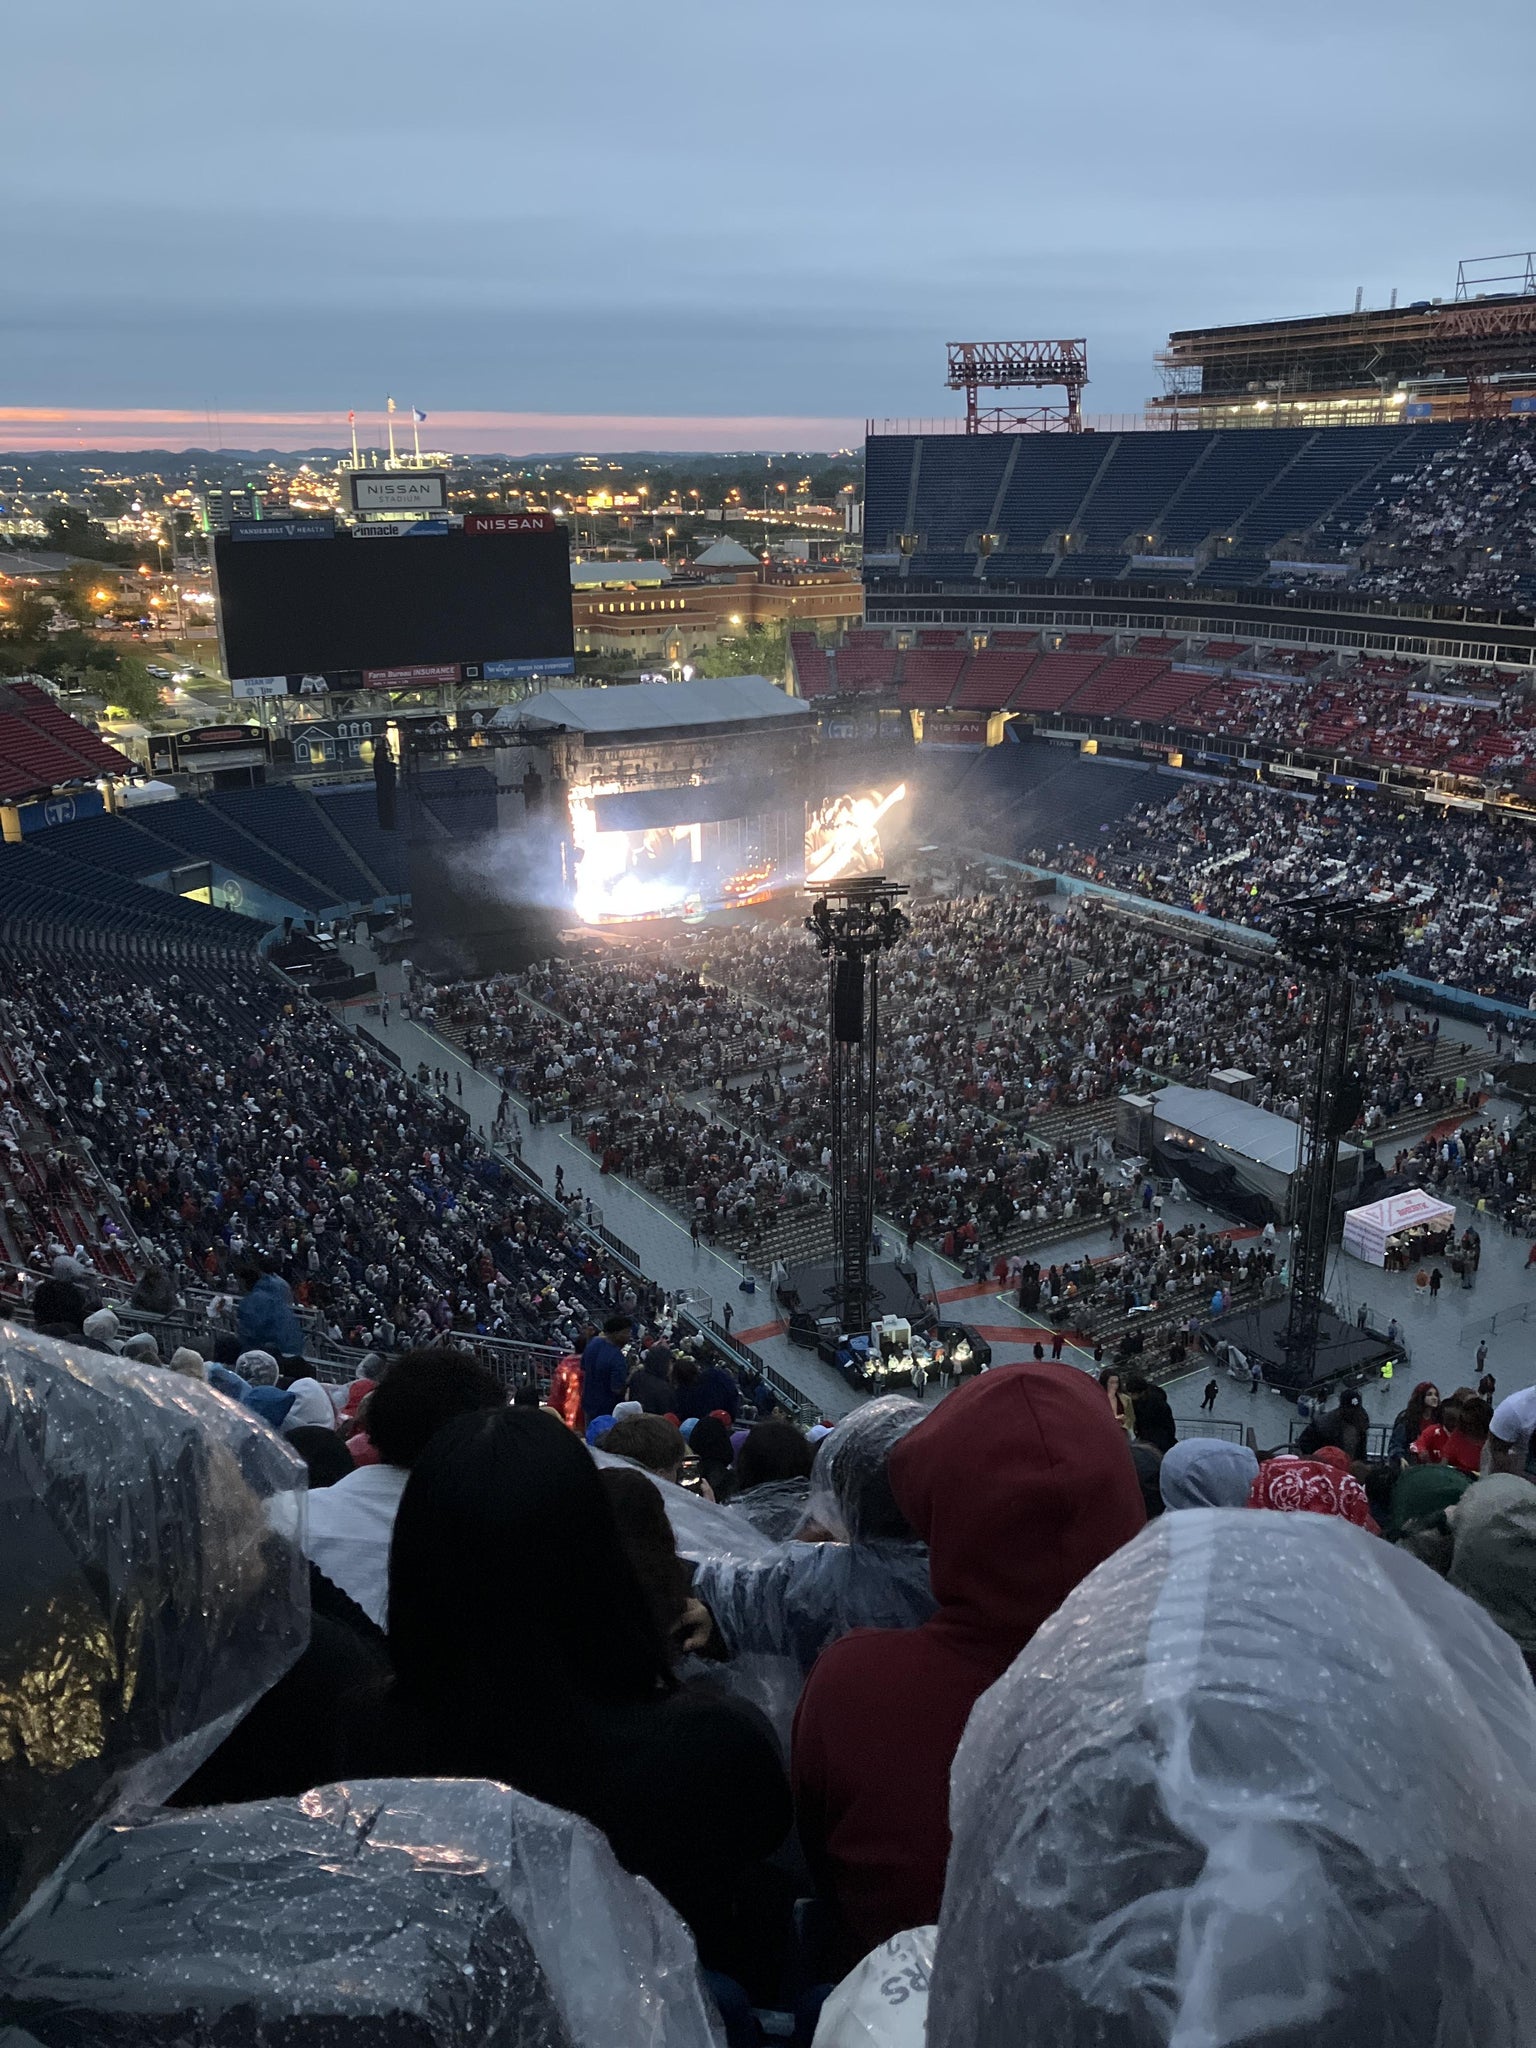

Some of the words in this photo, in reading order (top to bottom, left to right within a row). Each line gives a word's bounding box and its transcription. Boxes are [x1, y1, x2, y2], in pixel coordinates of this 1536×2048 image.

[367, 485, 430, 494] NISSAN
[378, 495, 421, 503] STADIUM
[476, 518, 544, 530] NISSAN
[239, 527, 284, 535] VANDERBILT
[353, 524, 399, 537] Pinnacle
[387, 670, 412, 678] Bureau
[413, 667, 456, 676] INSURANCE
[929, 723, 980, 733] NISSAN
